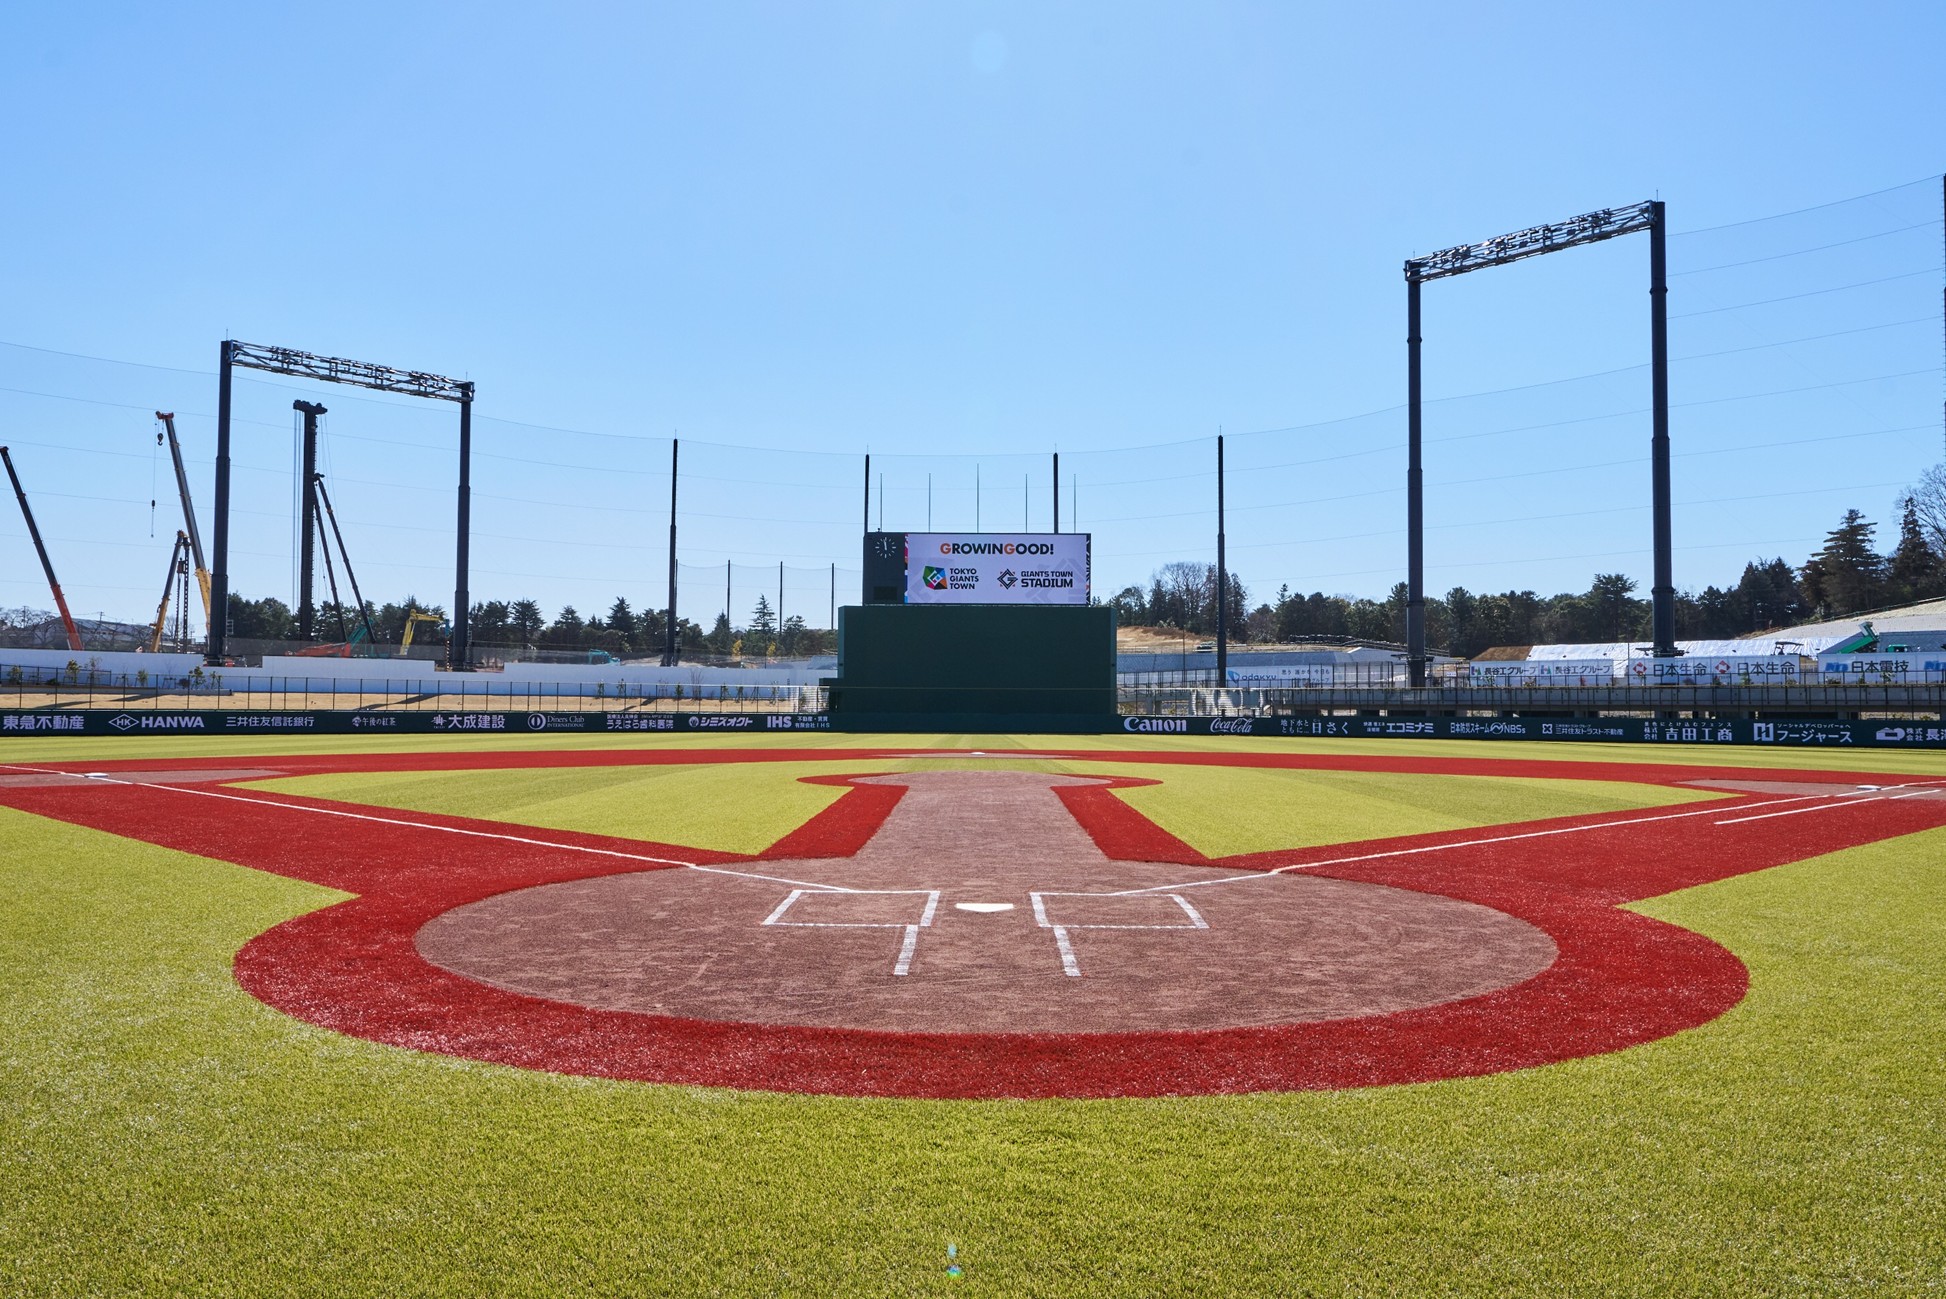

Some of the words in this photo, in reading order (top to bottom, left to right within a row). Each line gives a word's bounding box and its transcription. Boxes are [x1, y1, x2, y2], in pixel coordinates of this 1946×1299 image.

[940, 543, 1054, 555] GROWINGOOD!
[1021, 578, 1073, 588] STADIUM
[1484, 666, 1538, 676] 長谷工グループ
[1555, 665, 1611, 675] 長谷工グループ
[1653, 663, 1707, 676] 日本生命
[1737, 661, 1795, 675] 日本生命
[1851, 660, 1909, 673] 日本電技
[3, 715, 85, 730] 東急不動産
[117, 718, 131, 726] HK
[141, 716, 205, 728] HANWA
[226, 716, 315, 727] 三井住友信託銀行
[362, 717, 396, 727] 午後の紅茶
[448, 715, 505, 729] 大成建設
[547, 715, 567, 723] Diners
[569, 715, 584, 723] Club
[606, 720, 673, 730] うえはら歯科医院
[700, 717, 753, 727] シミズオクト
[767, 716, 792, 728] IHS
[1124, 717, 1187, 732] Canon
[1210, 717, 1254, 733] Coca-Cola
[1312, 722, 1348, 734] 日さく
[1386, 722, 1434, 733] エコミナミ
[1450, 722, 1490, 734] 日本防災スキーム
[1555, 728, 1624, 736] 三井住友トラスト不動産
[1665, 727, 1732, 741] 吉田工商
[1777, 729, 1852, 742] フージャース
